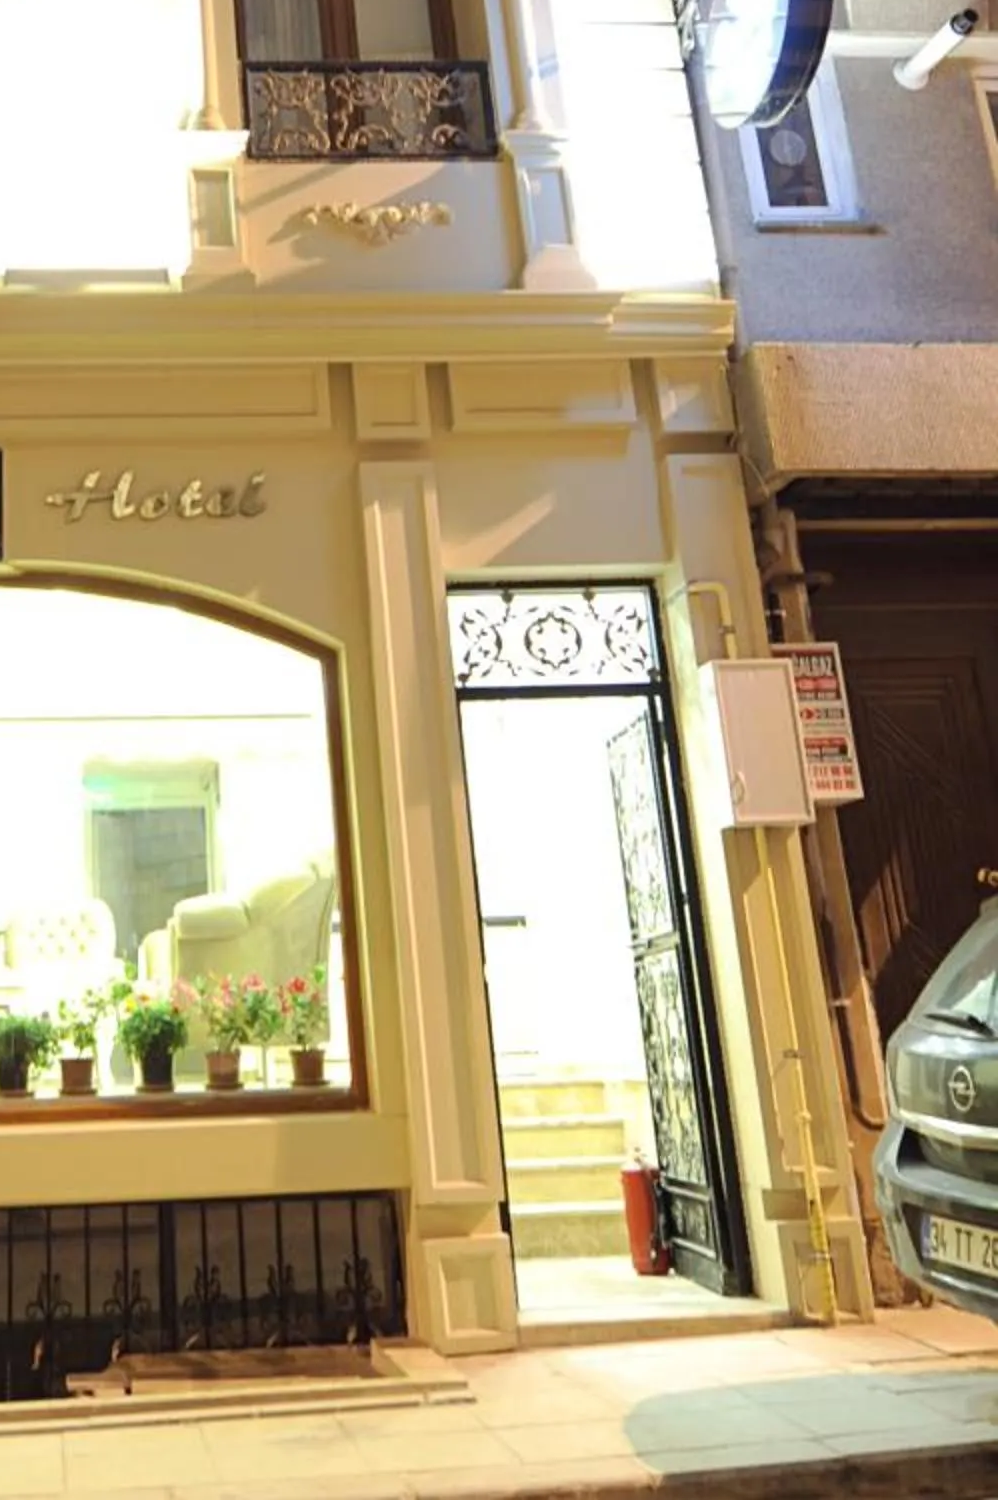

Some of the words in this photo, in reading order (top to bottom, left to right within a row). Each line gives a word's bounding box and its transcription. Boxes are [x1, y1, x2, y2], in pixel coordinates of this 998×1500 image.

[45, 470, 266, 522] Hotel
[931, 1221, 947, 1256] 34
[955, 1227, 973, 1263] TT
